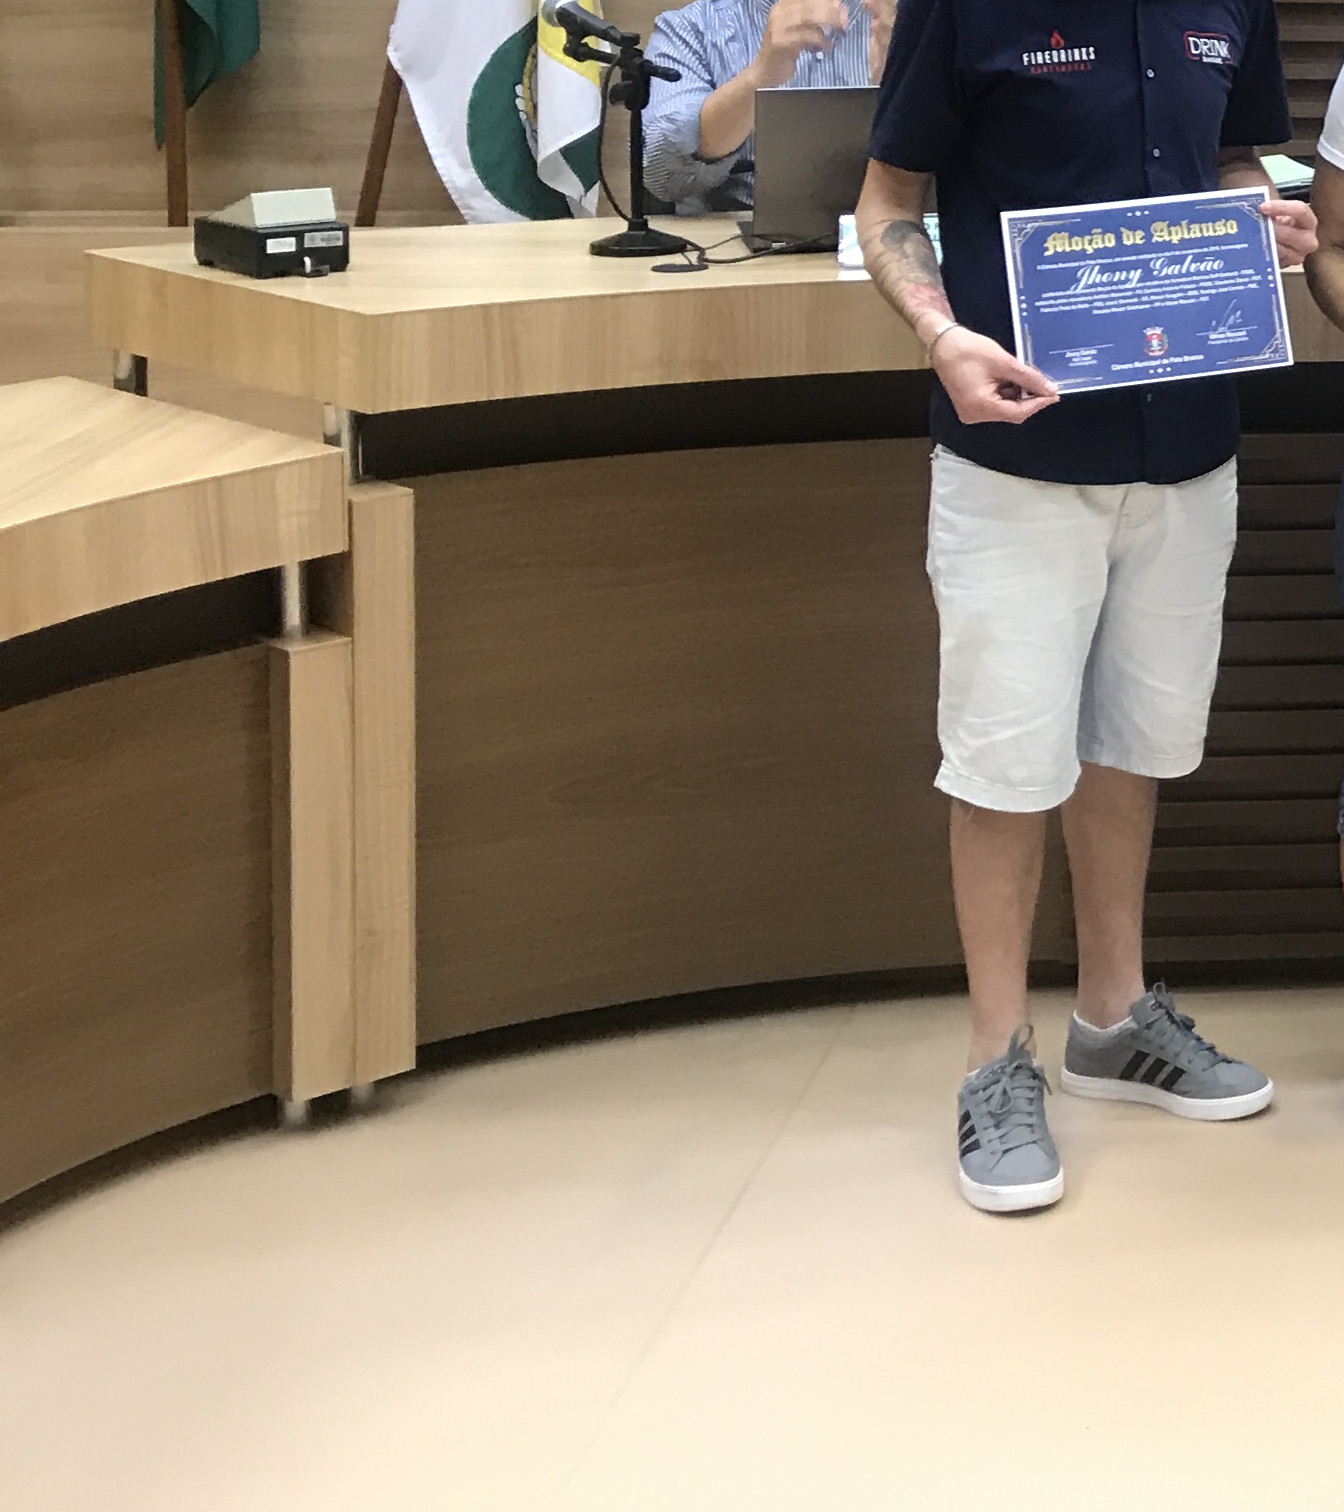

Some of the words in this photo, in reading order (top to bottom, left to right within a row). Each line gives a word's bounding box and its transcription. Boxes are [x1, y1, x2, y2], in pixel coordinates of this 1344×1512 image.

[1188, 37, 1231, 59] DRINK
[1043, 228, 1117, 256] Moção
[1121, 226, 1146, 245] de
[1152, 218, 1239, 246] Aplauso
[1070, 264, 1143, 293] Jhony
[1149, 255, 1225, 278] Galvão
